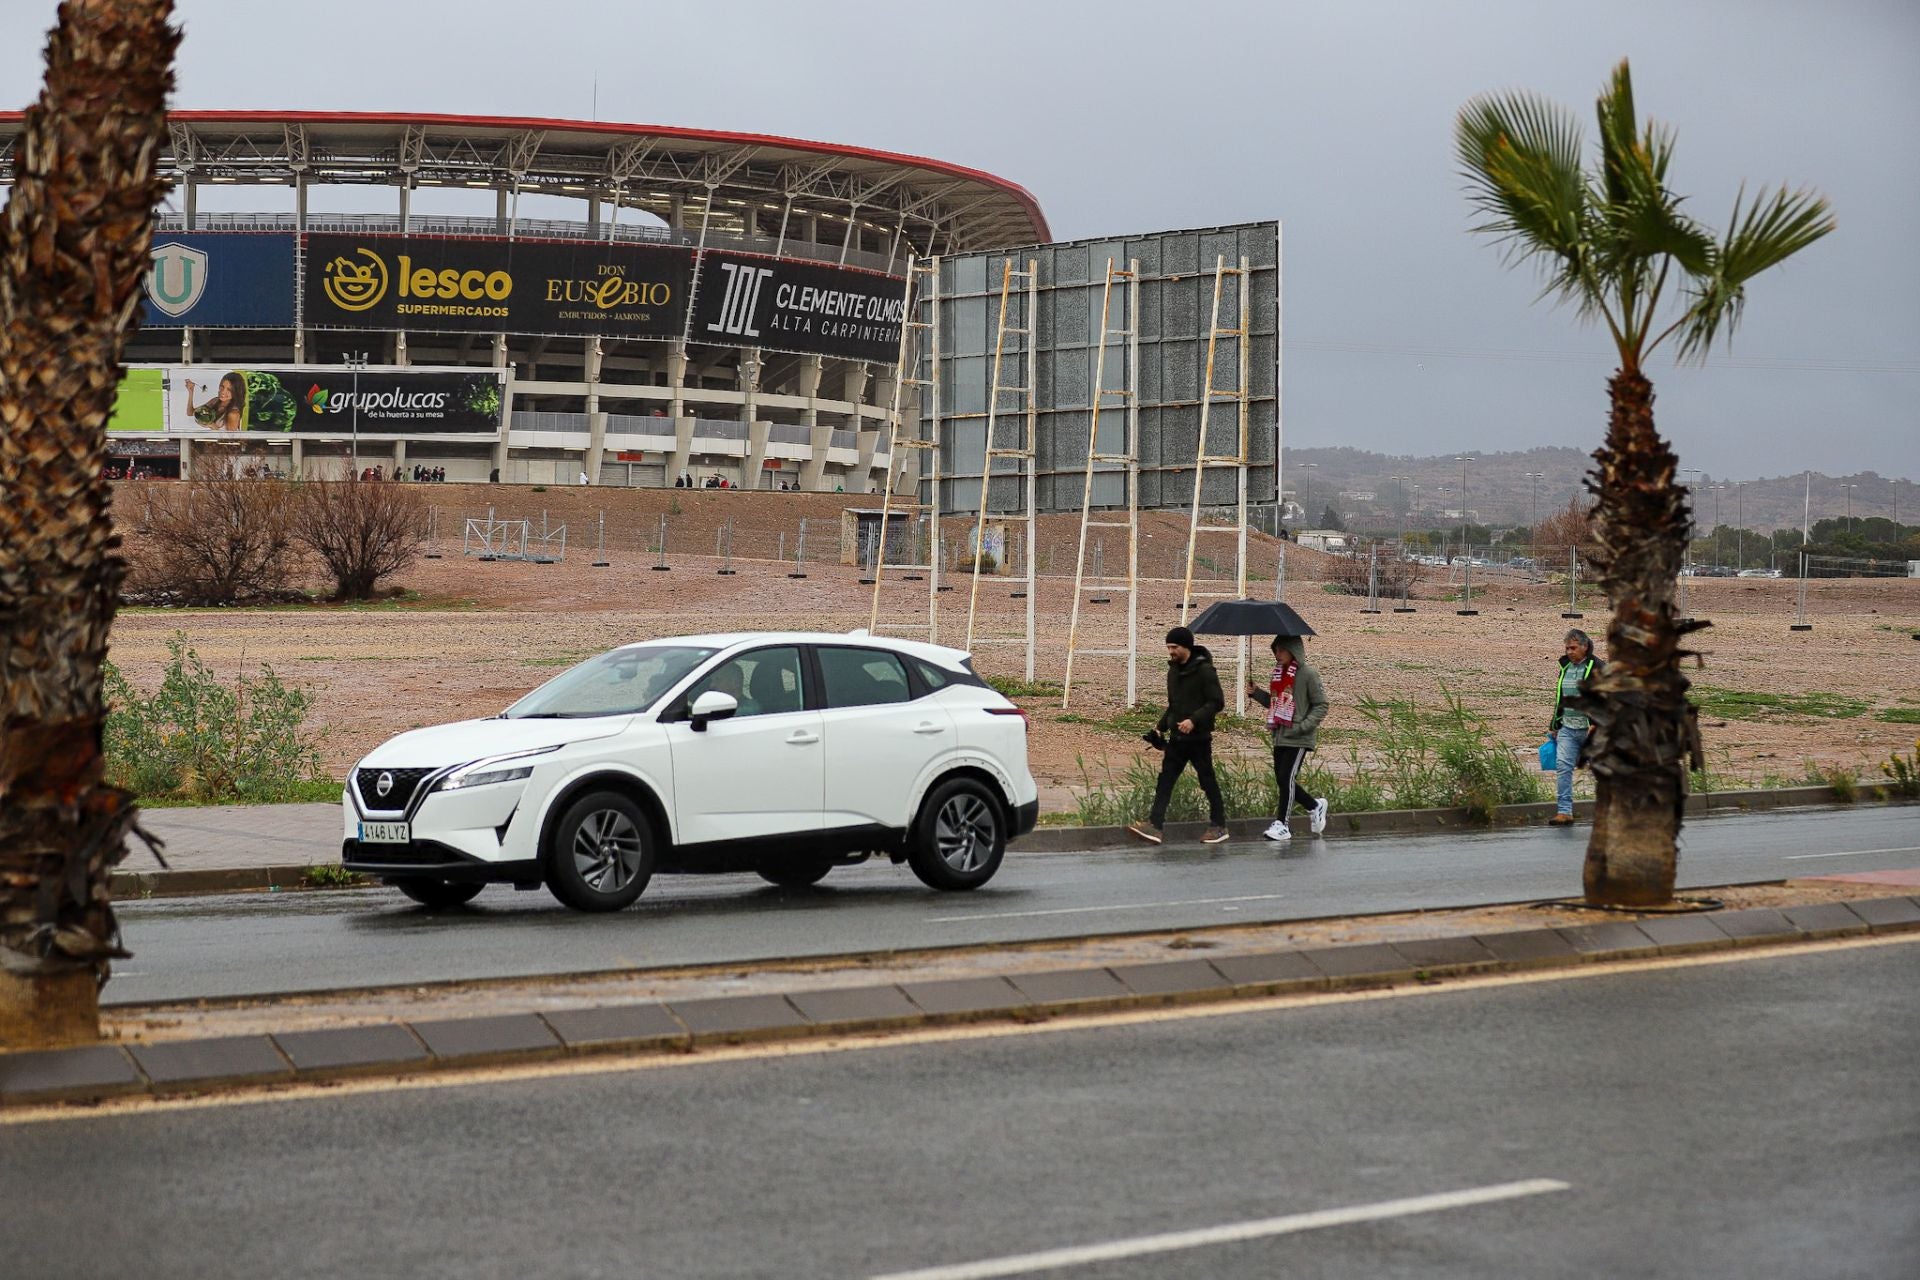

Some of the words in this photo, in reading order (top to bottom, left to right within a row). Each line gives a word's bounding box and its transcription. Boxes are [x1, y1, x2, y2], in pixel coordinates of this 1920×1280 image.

[397, 255, 513, 300] lesco
[598, 265, 626, 276] DON
[153, 255, 196, 305] U
[396, 303, 509, 317] SUPERMERCADOS
[776, 283, 866, 318] CLEMENTE
[866, 296, 905, 323] OLMOS
[558, 311, 607, 320] EMBUTIDOS
[614, 312, 650, 321] JAMONES
[770, 313, 812, 333] ALTA
[387, 824, 407, 840] LYZ
